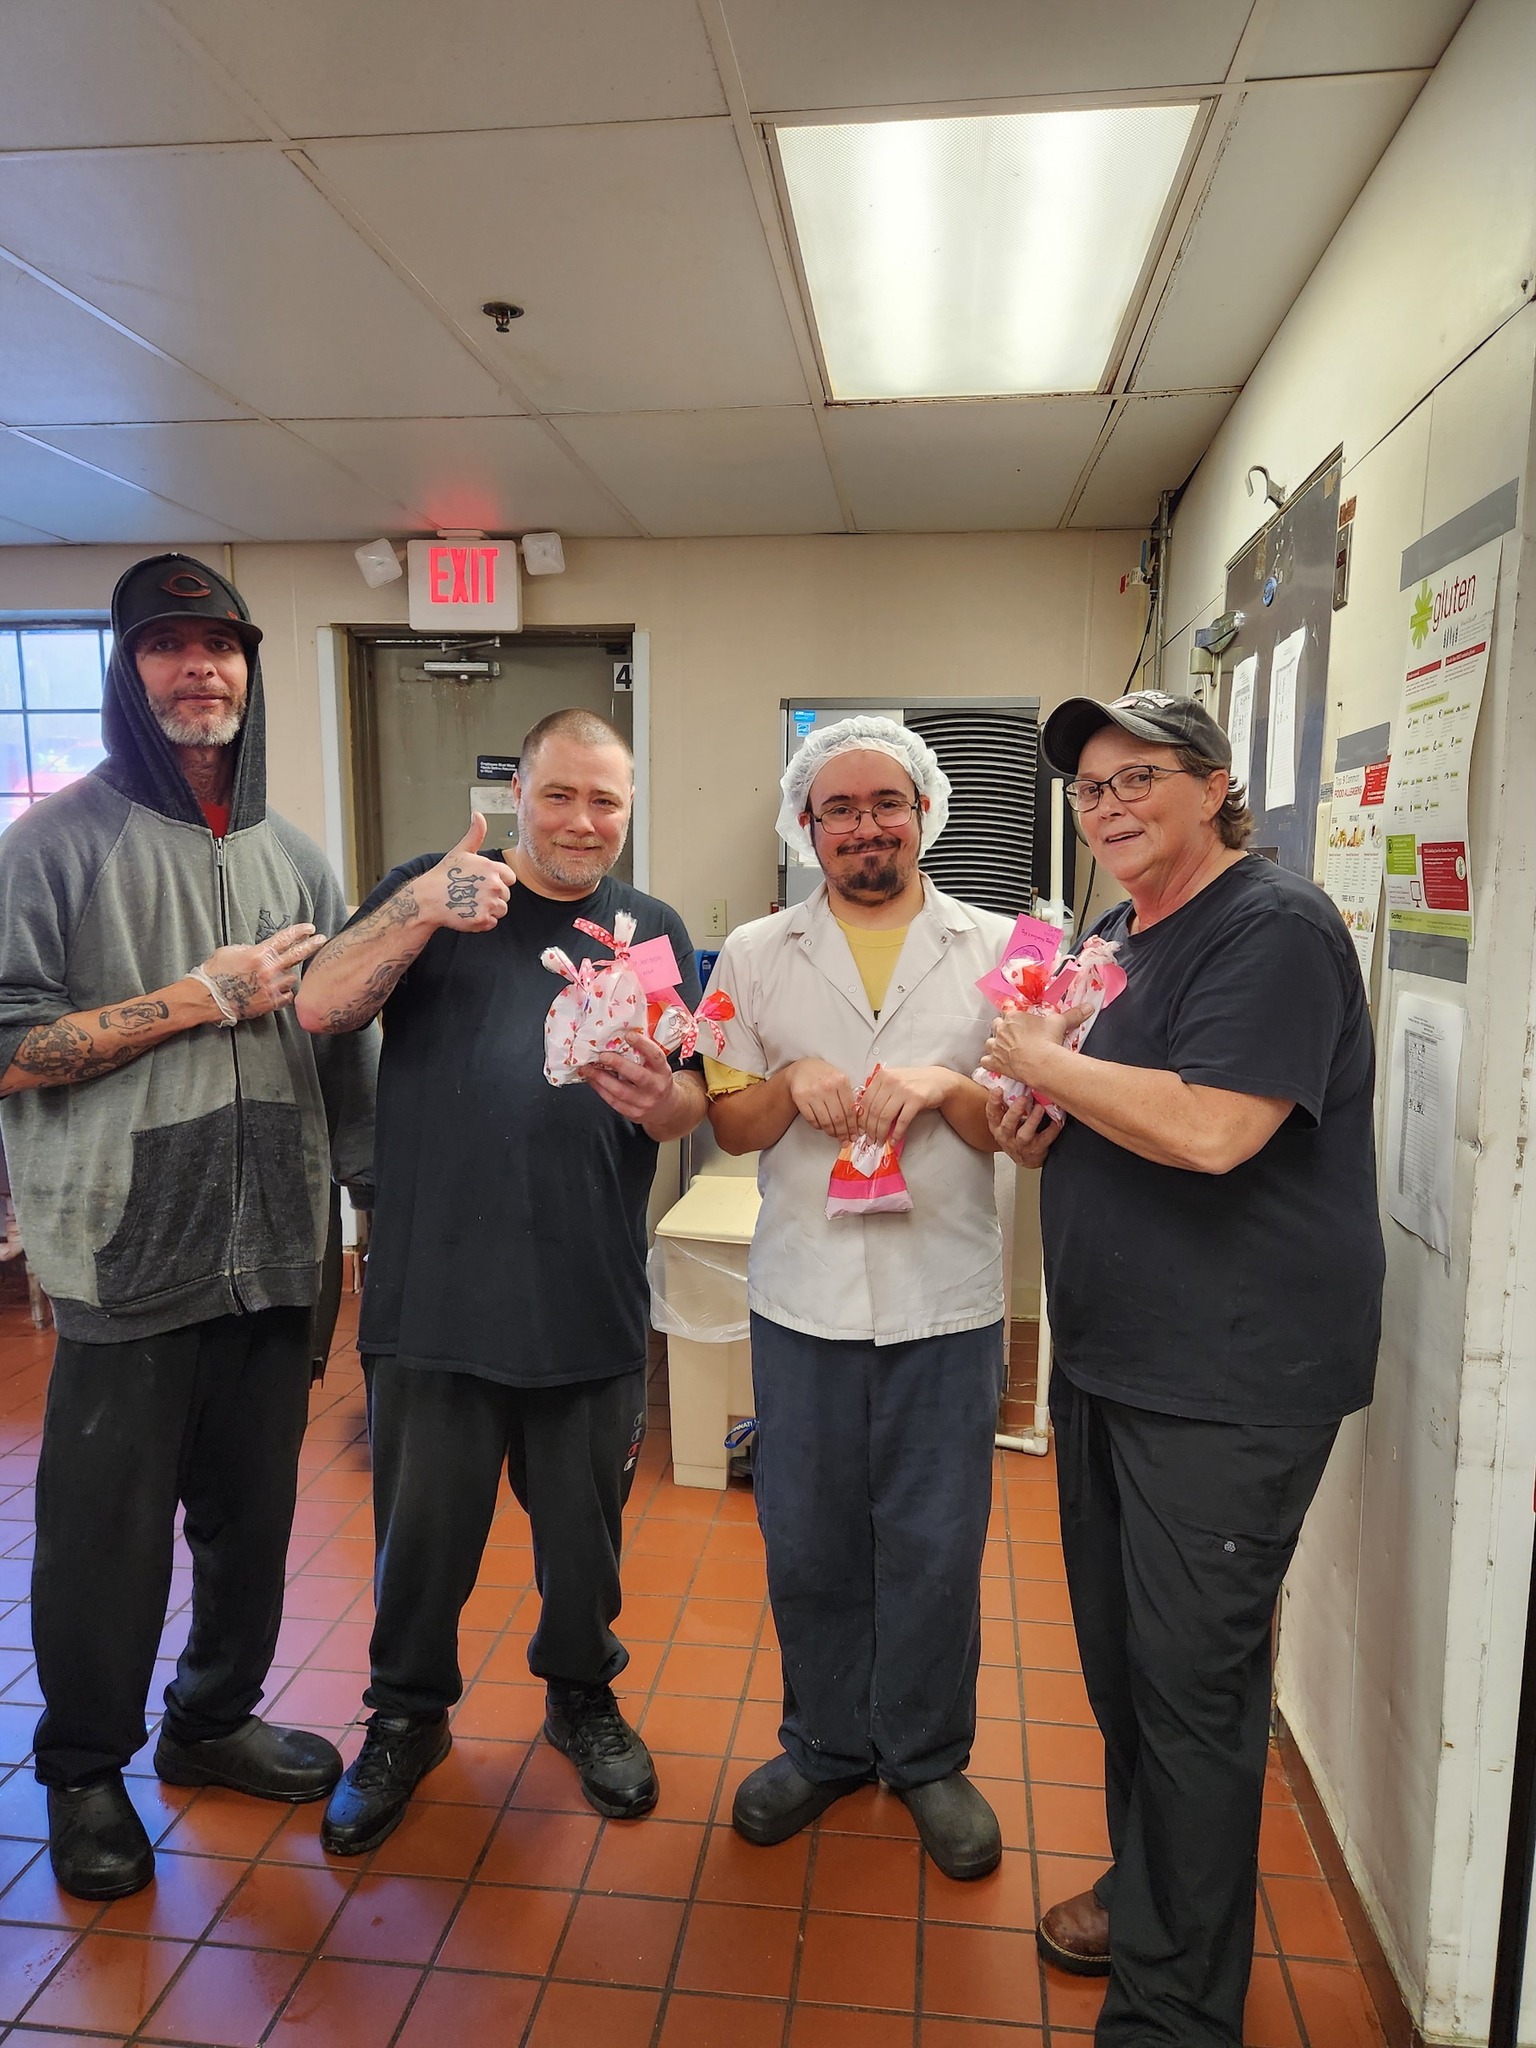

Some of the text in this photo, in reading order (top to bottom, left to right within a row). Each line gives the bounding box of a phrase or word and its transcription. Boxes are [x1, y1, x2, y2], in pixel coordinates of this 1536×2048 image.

[428, 547, 499, 604] EXIT
[1432, 574, 1476, 633] gluten
[616, 664, 632, 690] 4
[1334, 788, 1345, 798] FOOD
[1345, 785, 1363, 797] ALLERGENS
